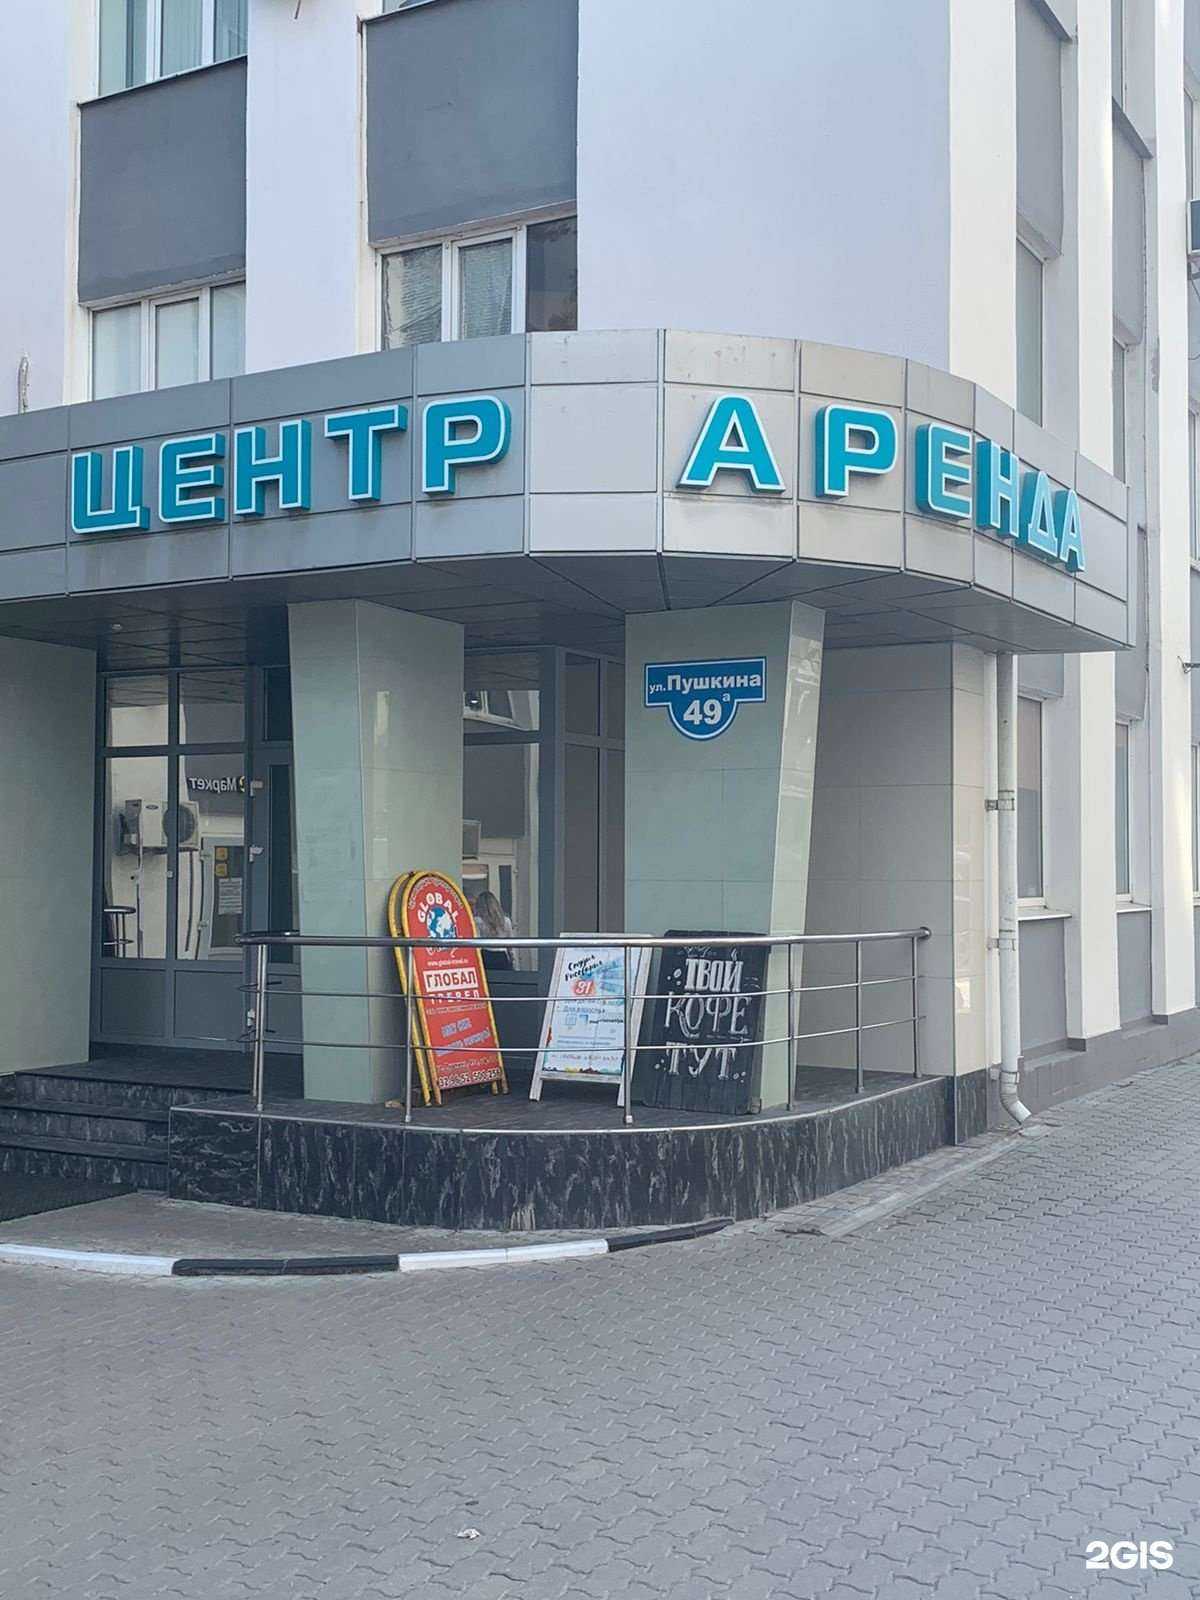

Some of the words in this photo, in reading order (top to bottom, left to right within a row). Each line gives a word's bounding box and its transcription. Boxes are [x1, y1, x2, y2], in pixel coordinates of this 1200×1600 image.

[71, 395, 511, 534] ЦЕНТР
[677, 393, 1086, 572] АРЕНДА
[667, 674, 761, 694] Пушкина
[425, 971, 477, 989] ГЛОБАЛ
[684, 947, 744, 993] ТВОЙ
[665, 991, 752, 1038] КОФЕ
[666, 1041, 737, 1080] ТУТ
